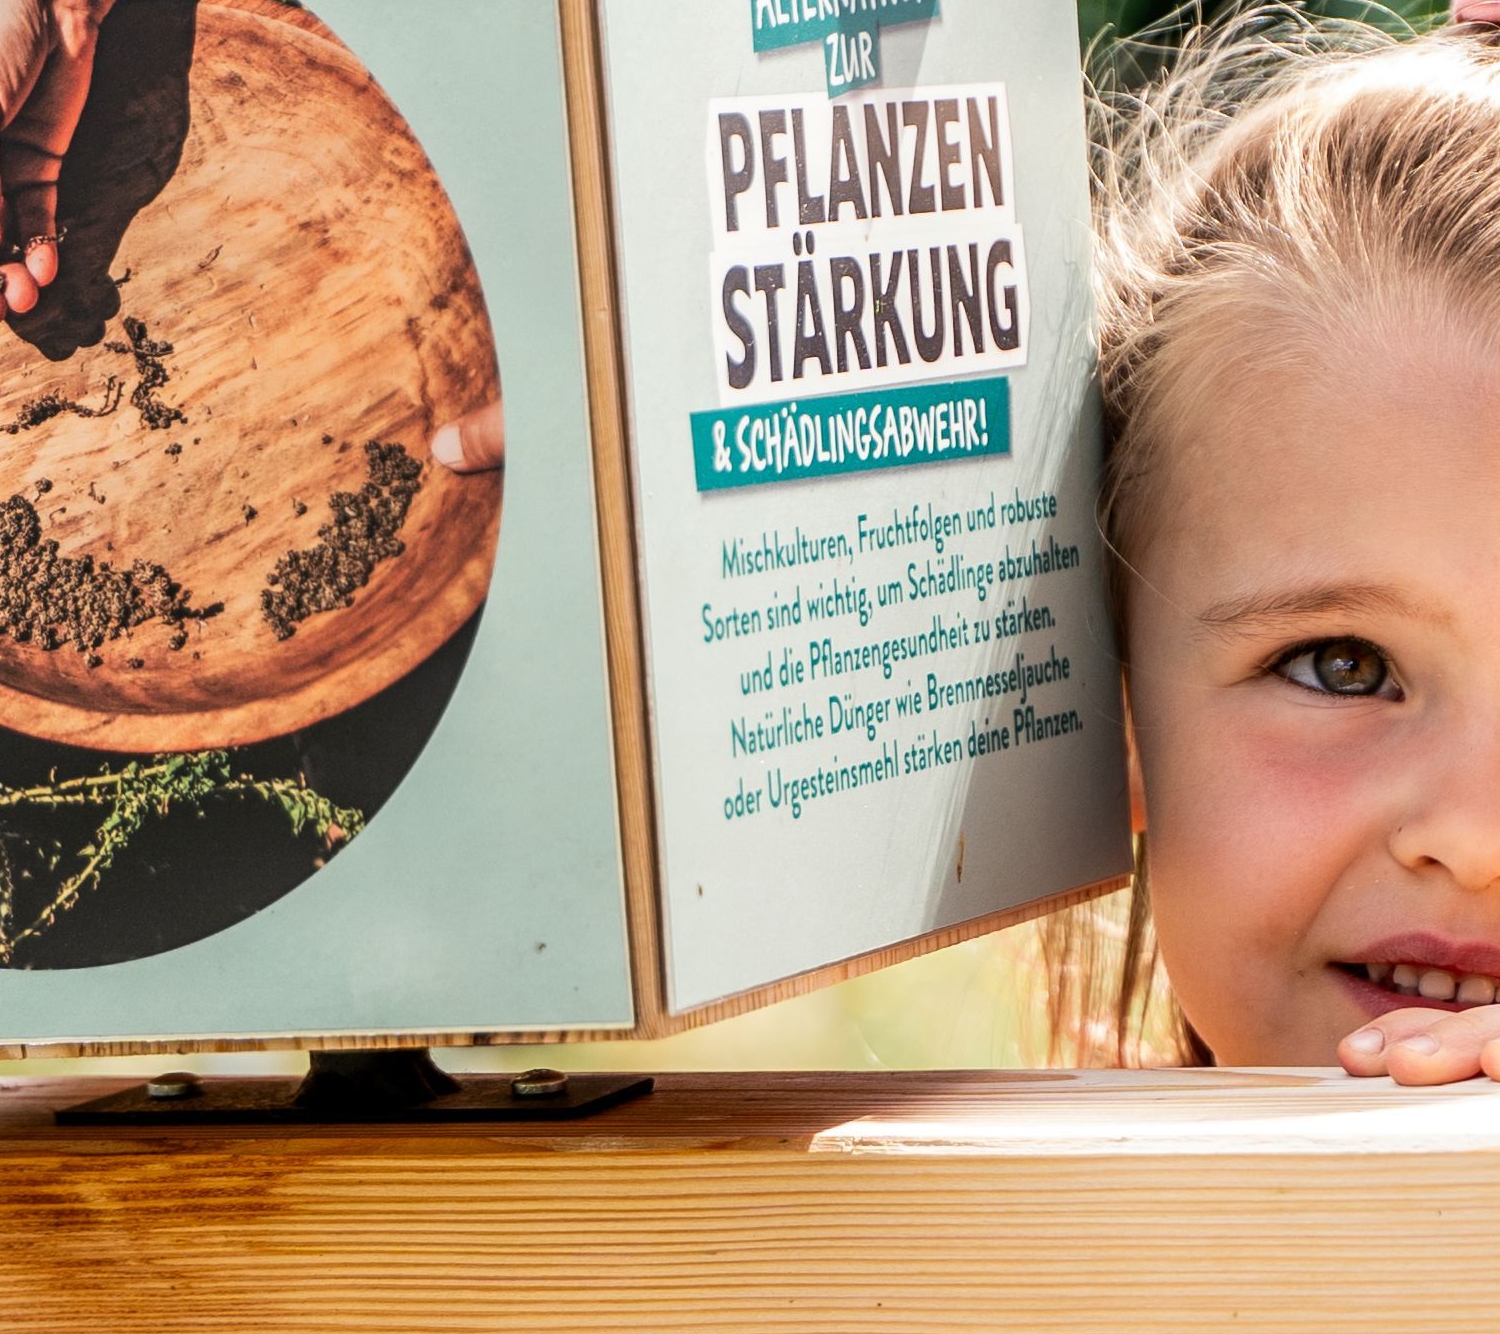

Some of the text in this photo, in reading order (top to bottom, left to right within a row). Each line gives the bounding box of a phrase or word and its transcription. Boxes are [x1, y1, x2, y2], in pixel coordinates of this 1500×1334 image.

[826, 31, 876, 87] ZUR
[718, 96, 1004, 232] PFLANZEN
[723, 231, 1019, 389] STÄRKUNG
[714, 398, 988, 474] & SCHÄDLINGSABWEHR!
[722, 488, 1057, 579] Mischkulturen, Fruchtfolgen und robuste
[701, 536, 1079, 644] Sorten sind wichtig, um Schädlinge abzuhalten
[740, 597, 1055, 696] und die Pflanzengesundheit zu stärken.
[731, 646, 1070, 758] Natürliche Dünger wie Brennnesseljauche
[723, 706, 1083, 820] oder Urgesteinsmehl stärken deine Pflanzen.
